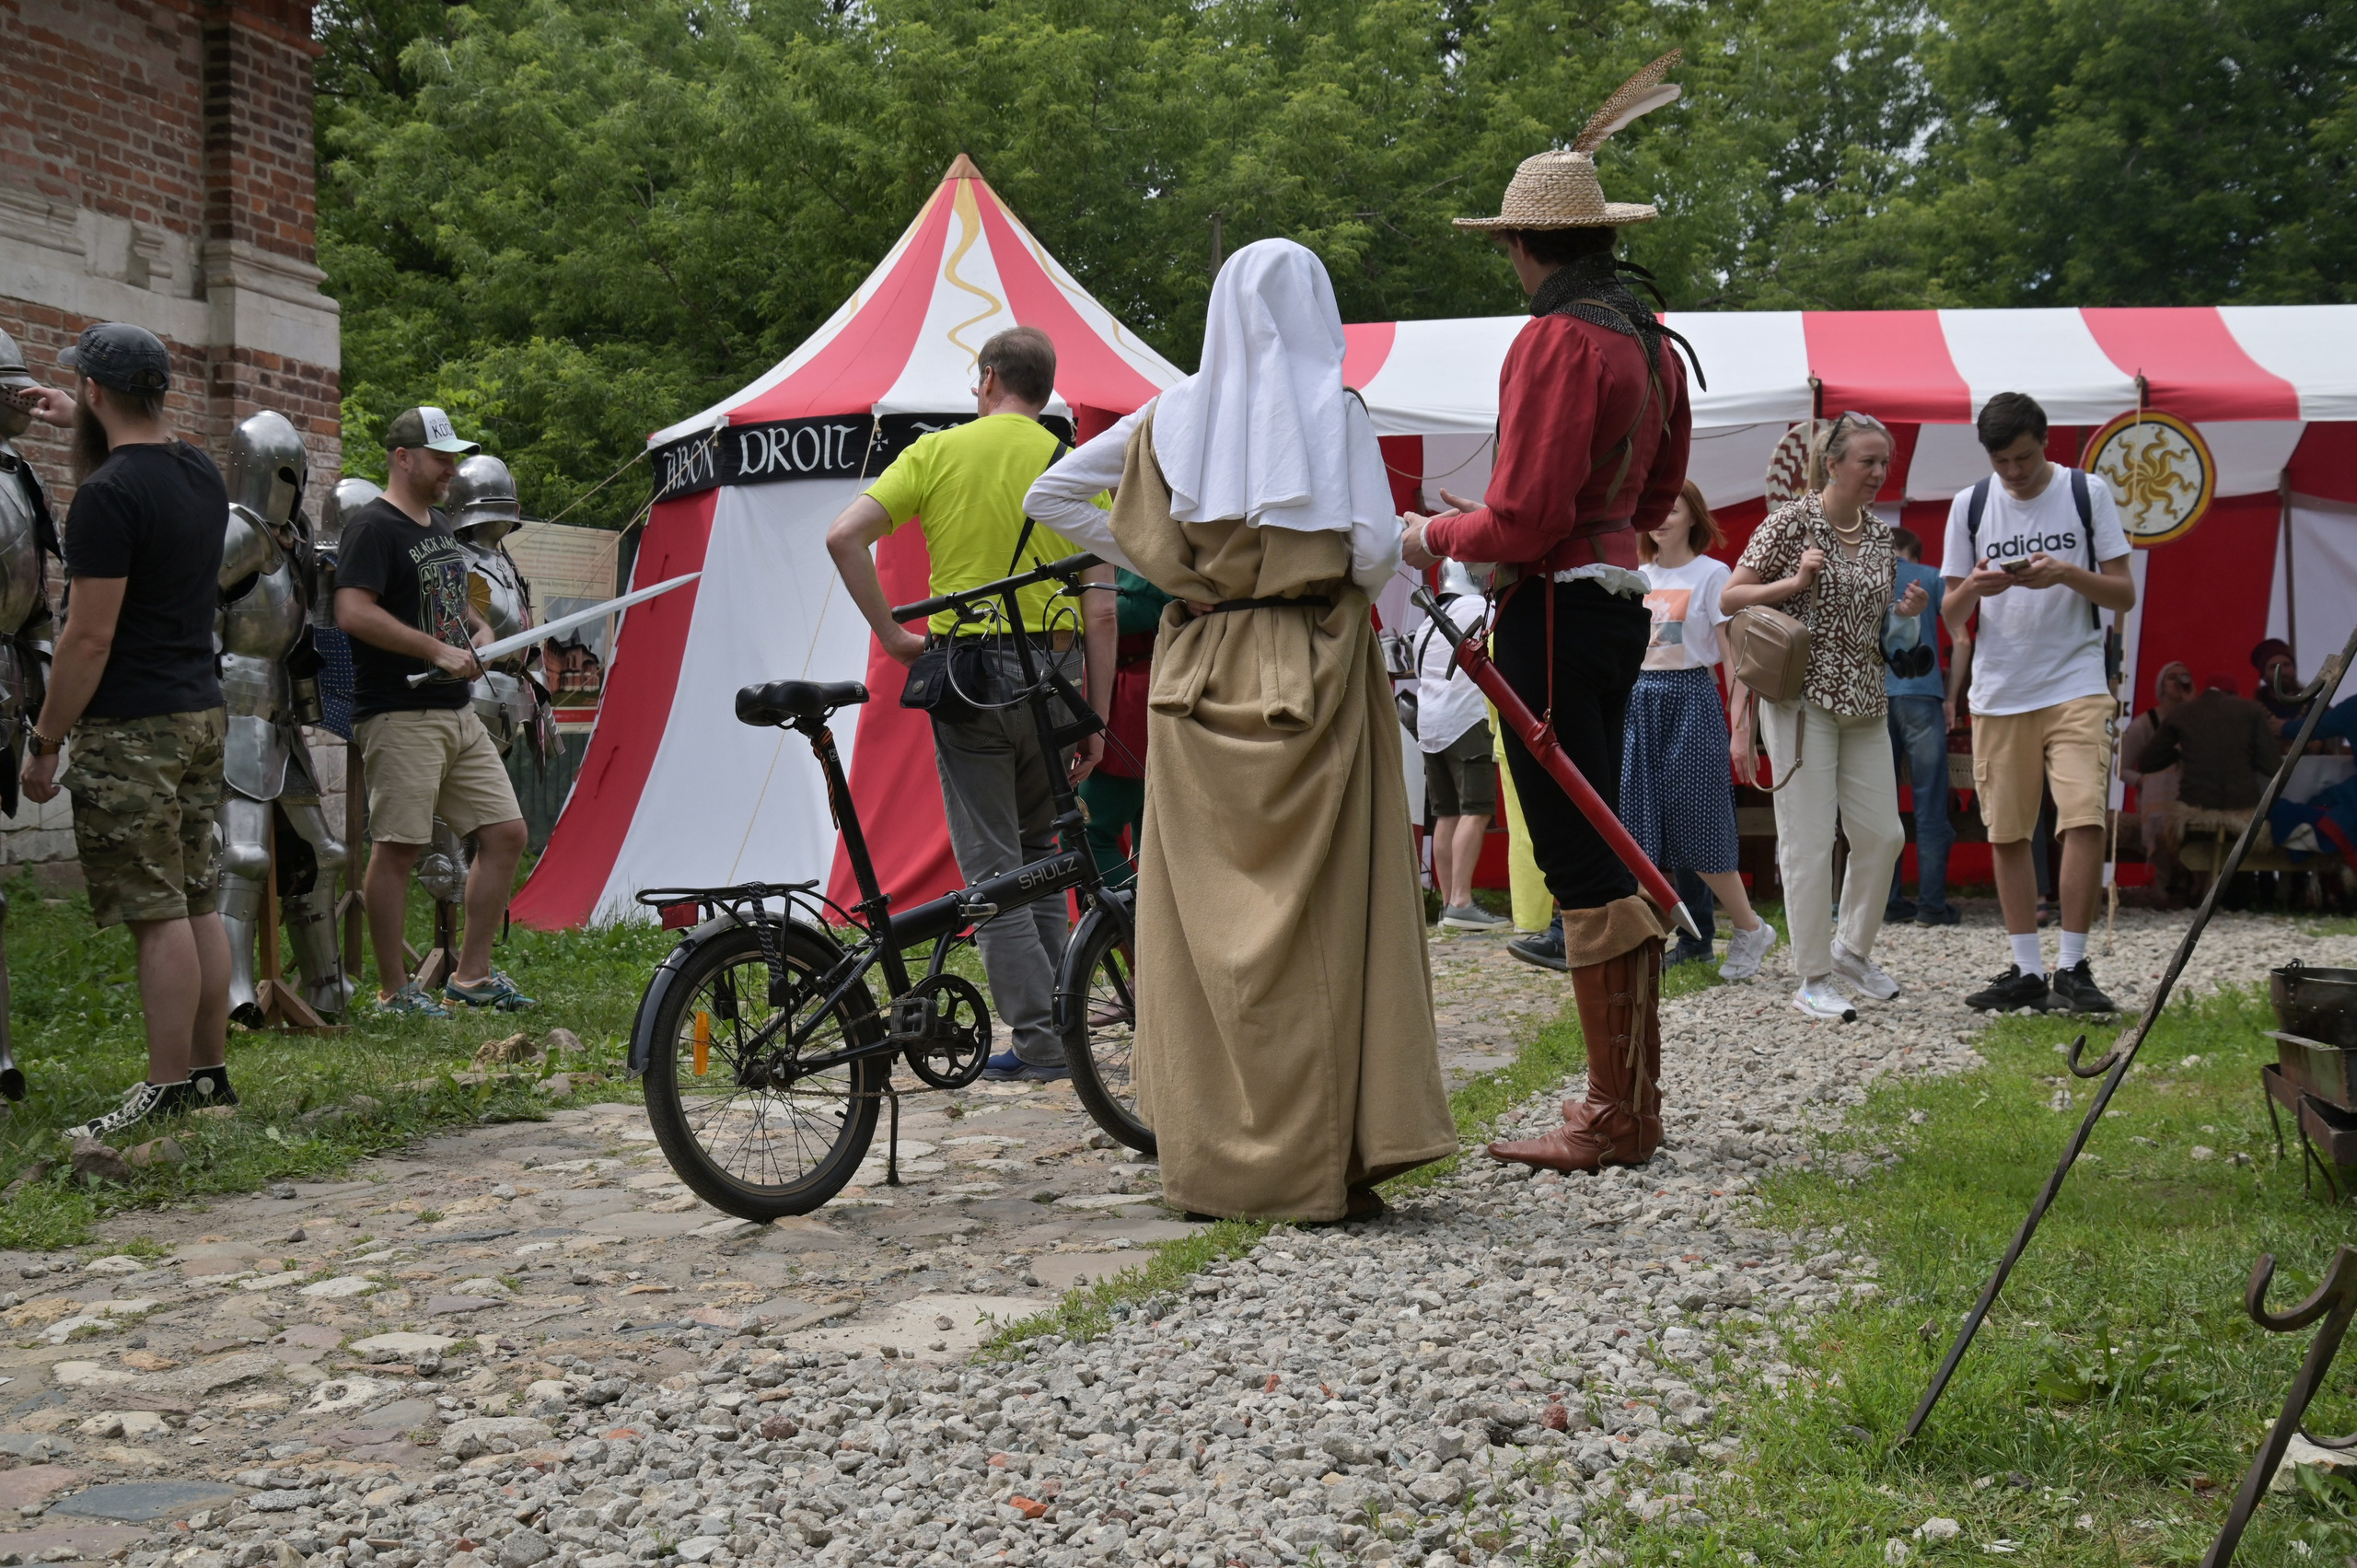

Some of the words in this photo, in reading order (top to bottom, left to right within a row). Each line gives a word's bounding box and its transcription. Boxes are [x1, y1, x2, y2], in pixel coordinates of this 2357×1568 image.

[738, 424, 858, 476] DROIT
[408, 537, 442, 563] BLACK
[438, 535, 460, 552] JAC
[1986, 532, 2077, 560] adidas
[1018, 856, 1078, 890] SHULZ
